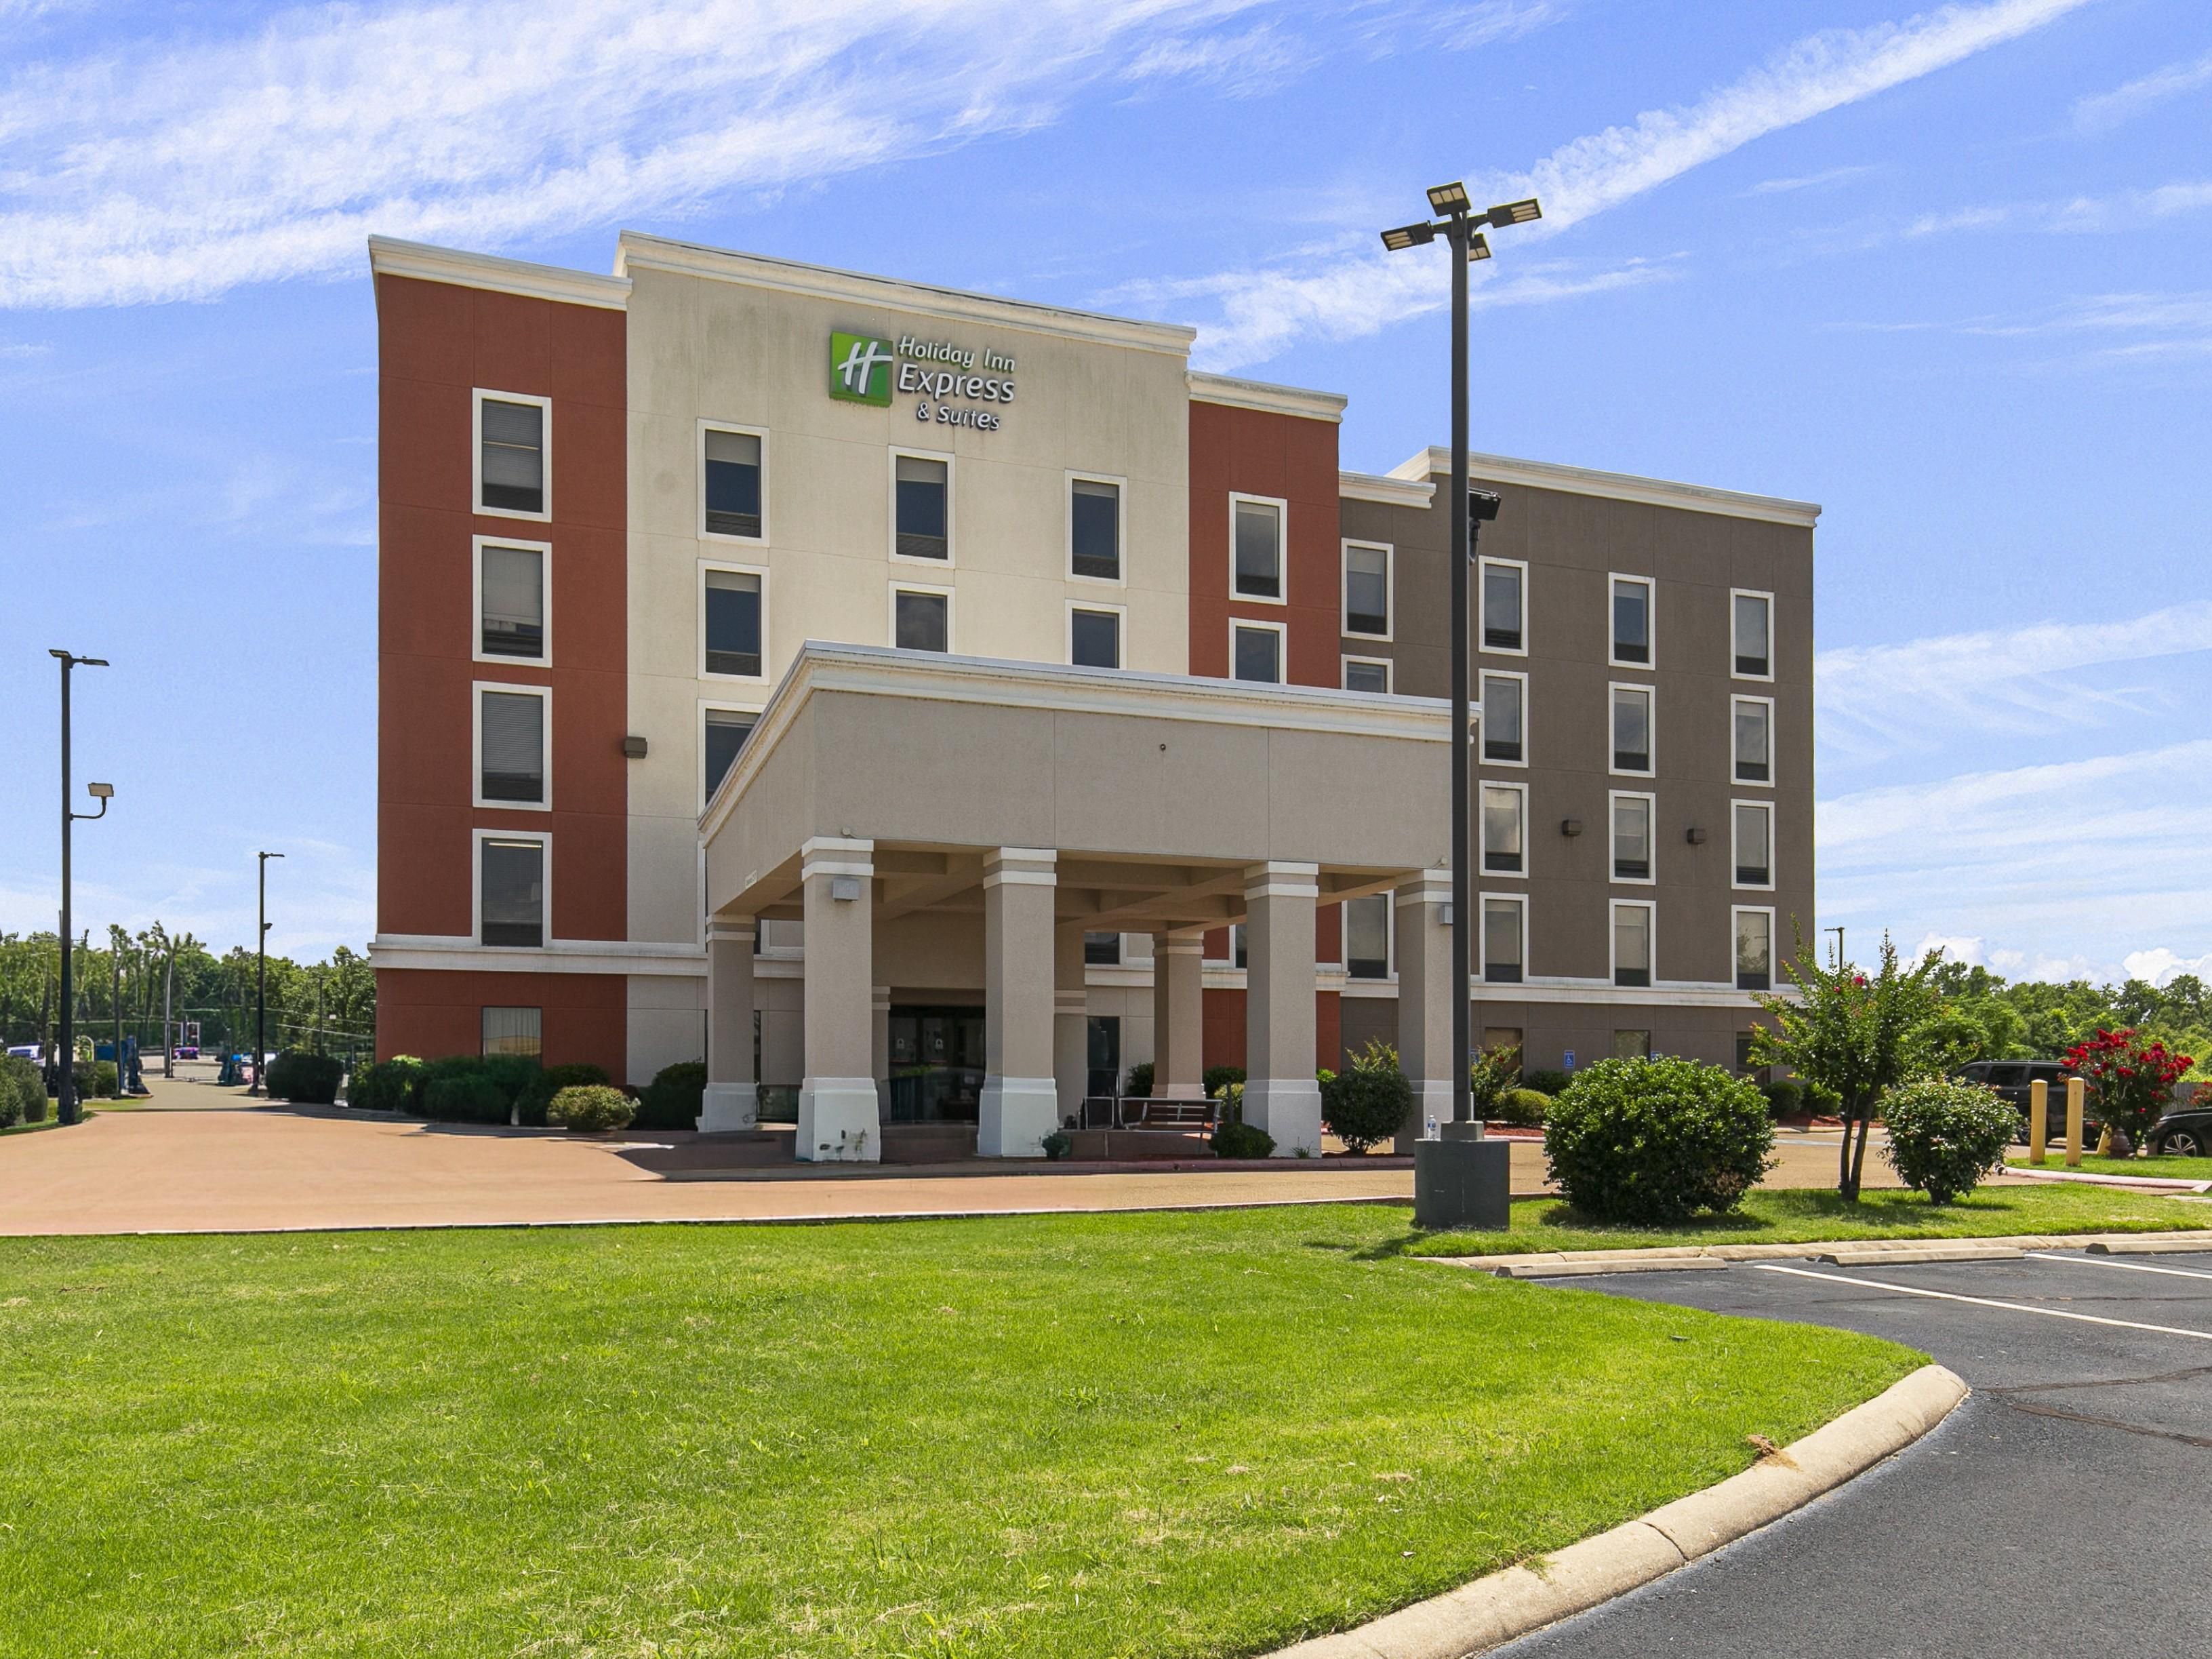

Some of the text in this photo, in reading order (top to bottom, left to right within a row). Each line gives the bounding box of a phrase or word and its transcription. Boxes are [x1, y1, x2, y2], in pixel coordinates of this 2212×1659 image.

[899, 336, 1015, 372] Holiday Inn
[898, 363, 1015, 402] Express
[917, 402, 1000, 430] & Suites
